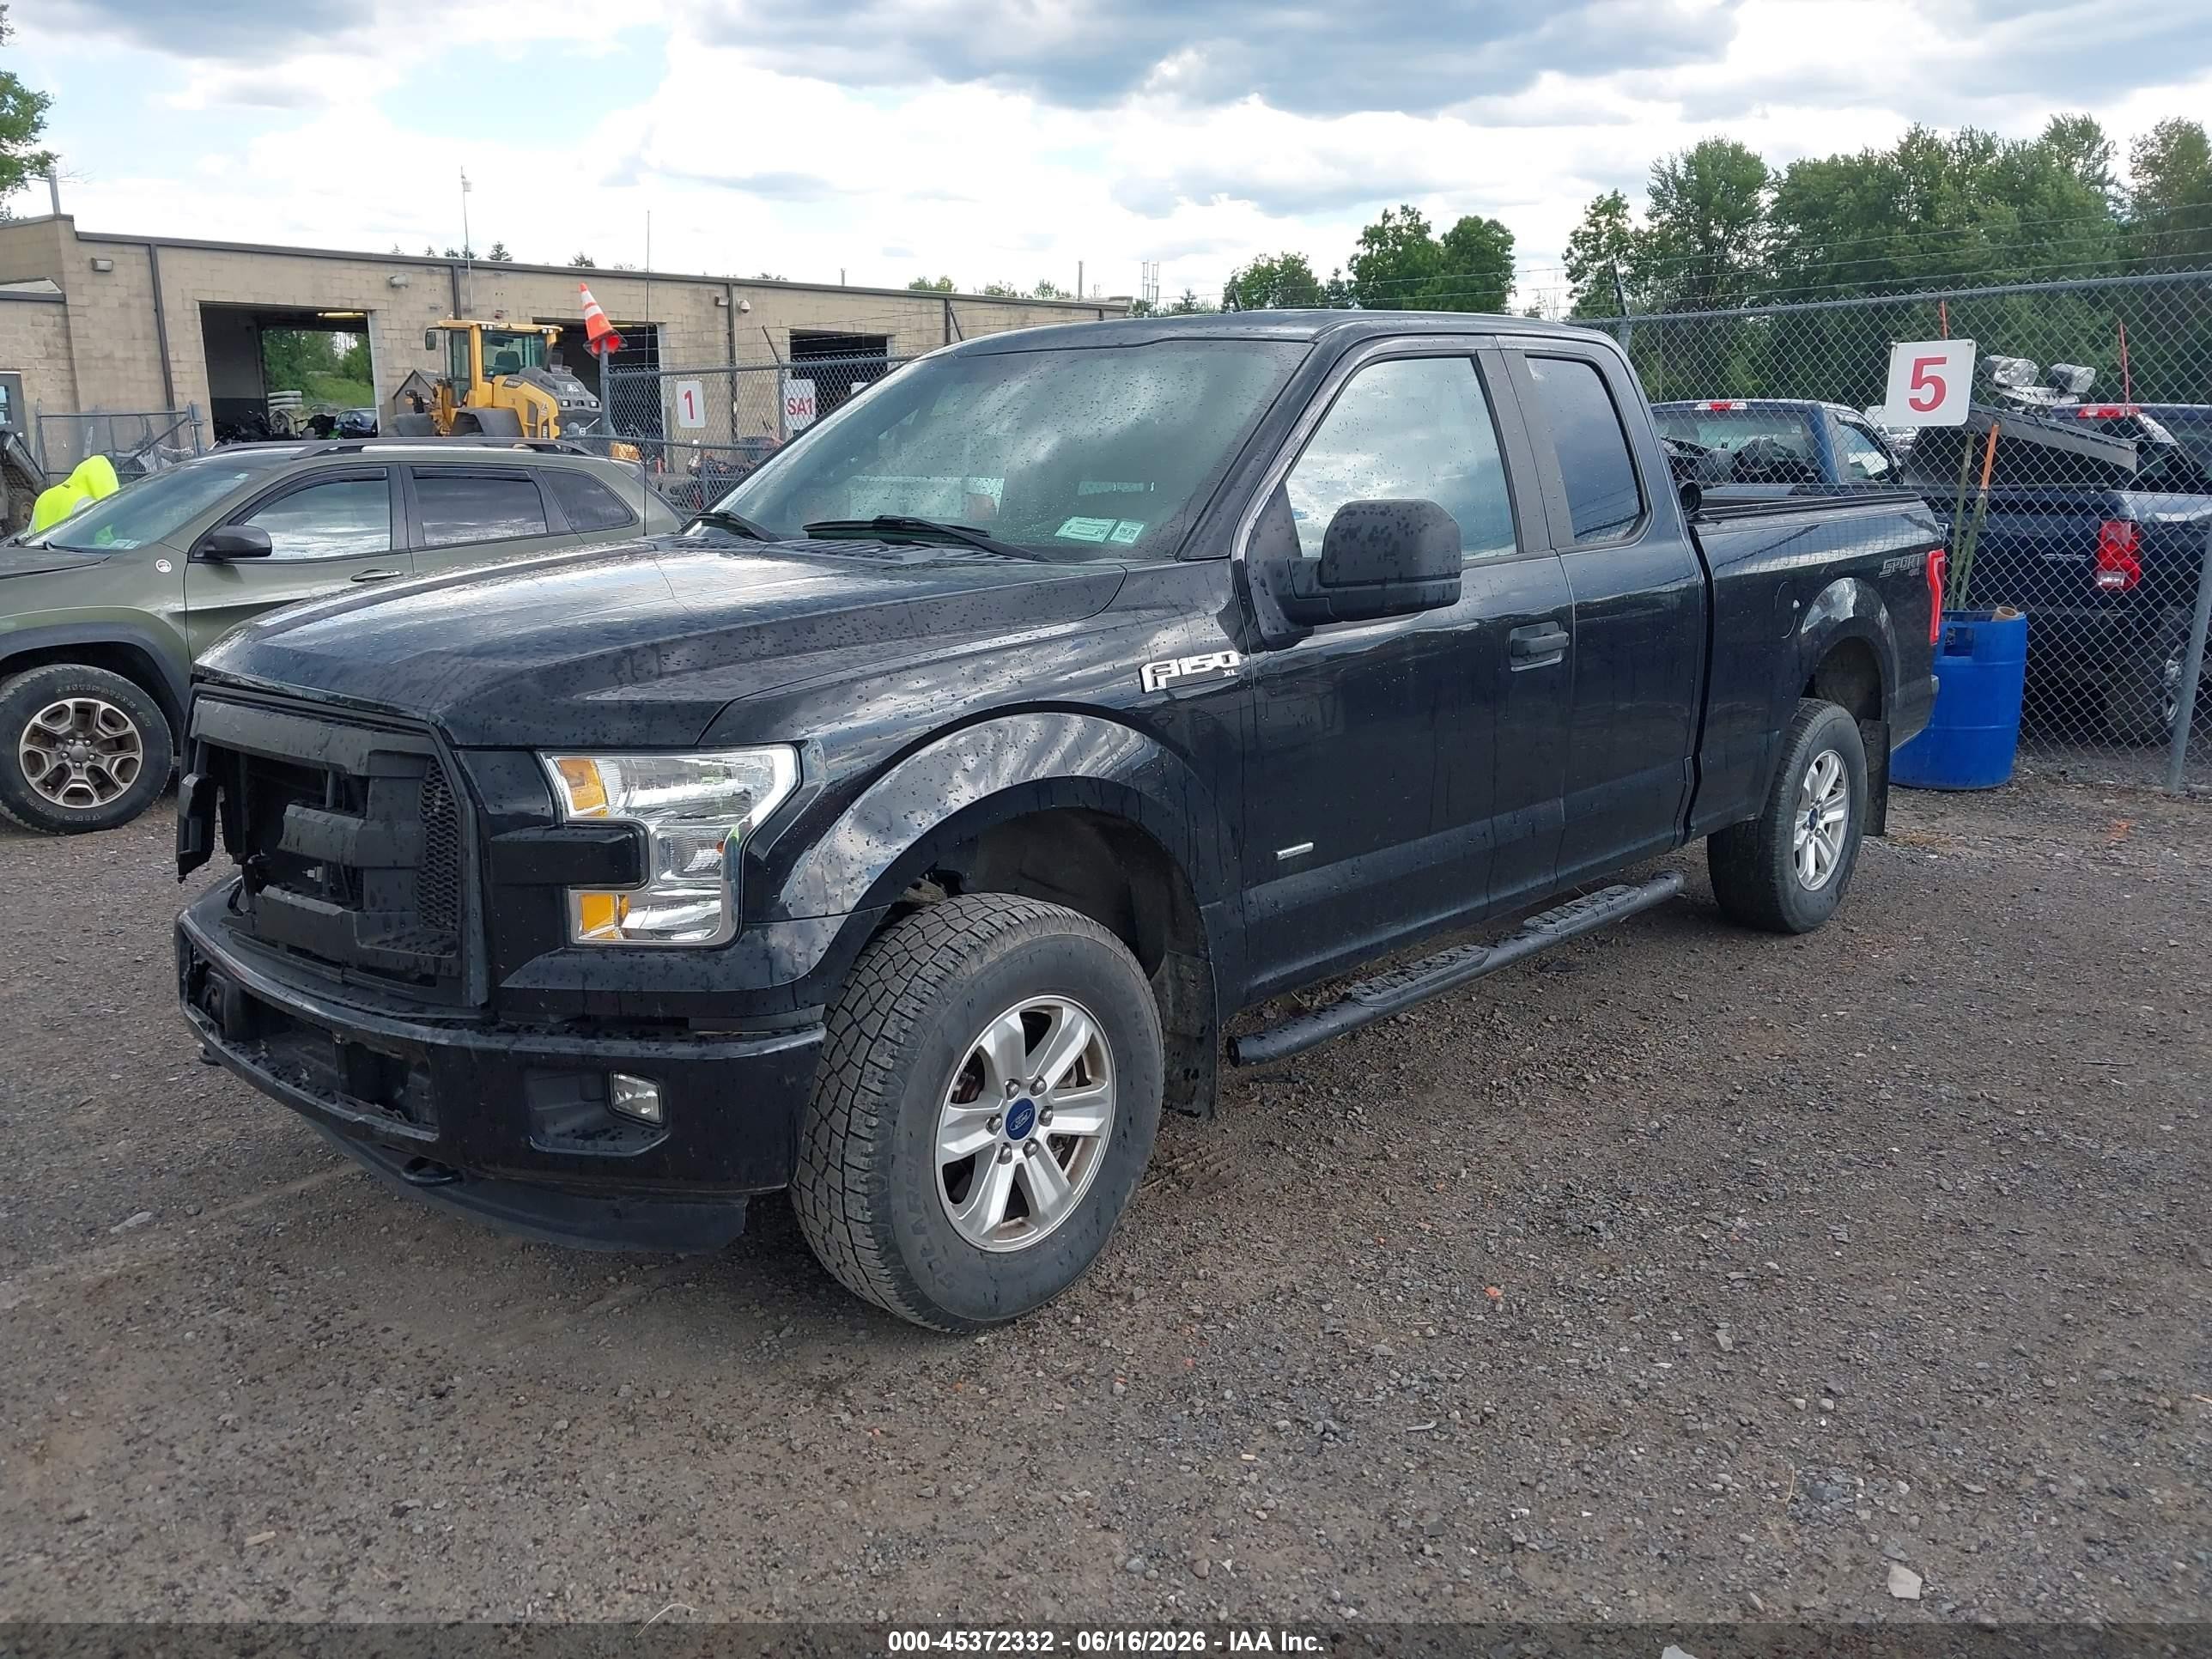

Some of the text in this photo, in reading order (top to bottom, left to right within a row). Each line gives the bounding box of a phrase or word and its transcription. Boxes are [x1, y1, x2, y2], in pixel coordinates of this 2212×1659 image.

[1908, 356, 1948, 412] 5
[684, 389, 695, 420] 1
[787, 397, 813, 416] SA1
[1878, 552, 1925, 579] SPORT
[1223, 669, 1238, 678] XL
